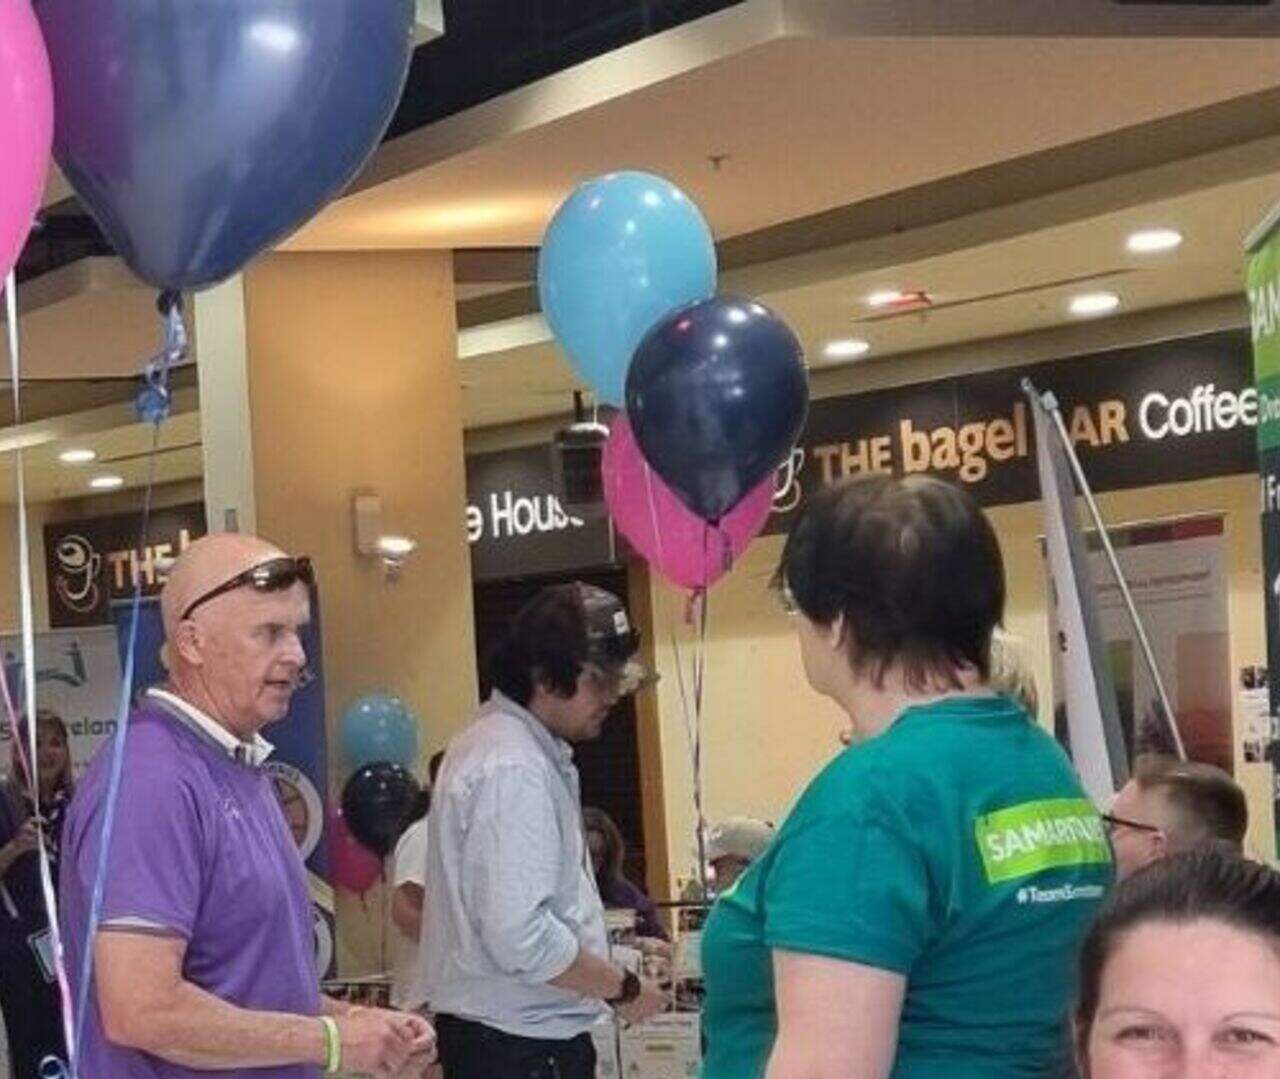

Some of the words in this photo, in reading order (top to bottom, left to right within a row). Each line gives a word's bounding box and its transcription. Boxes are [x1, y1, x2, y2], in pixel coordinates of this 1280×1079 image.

[813, 436, 892, 485] THE
[900, 402, 1027, 482] bagel
[1069, 400, 1130, 448] AR
[1139, 383, 1258, 440] Coffee
